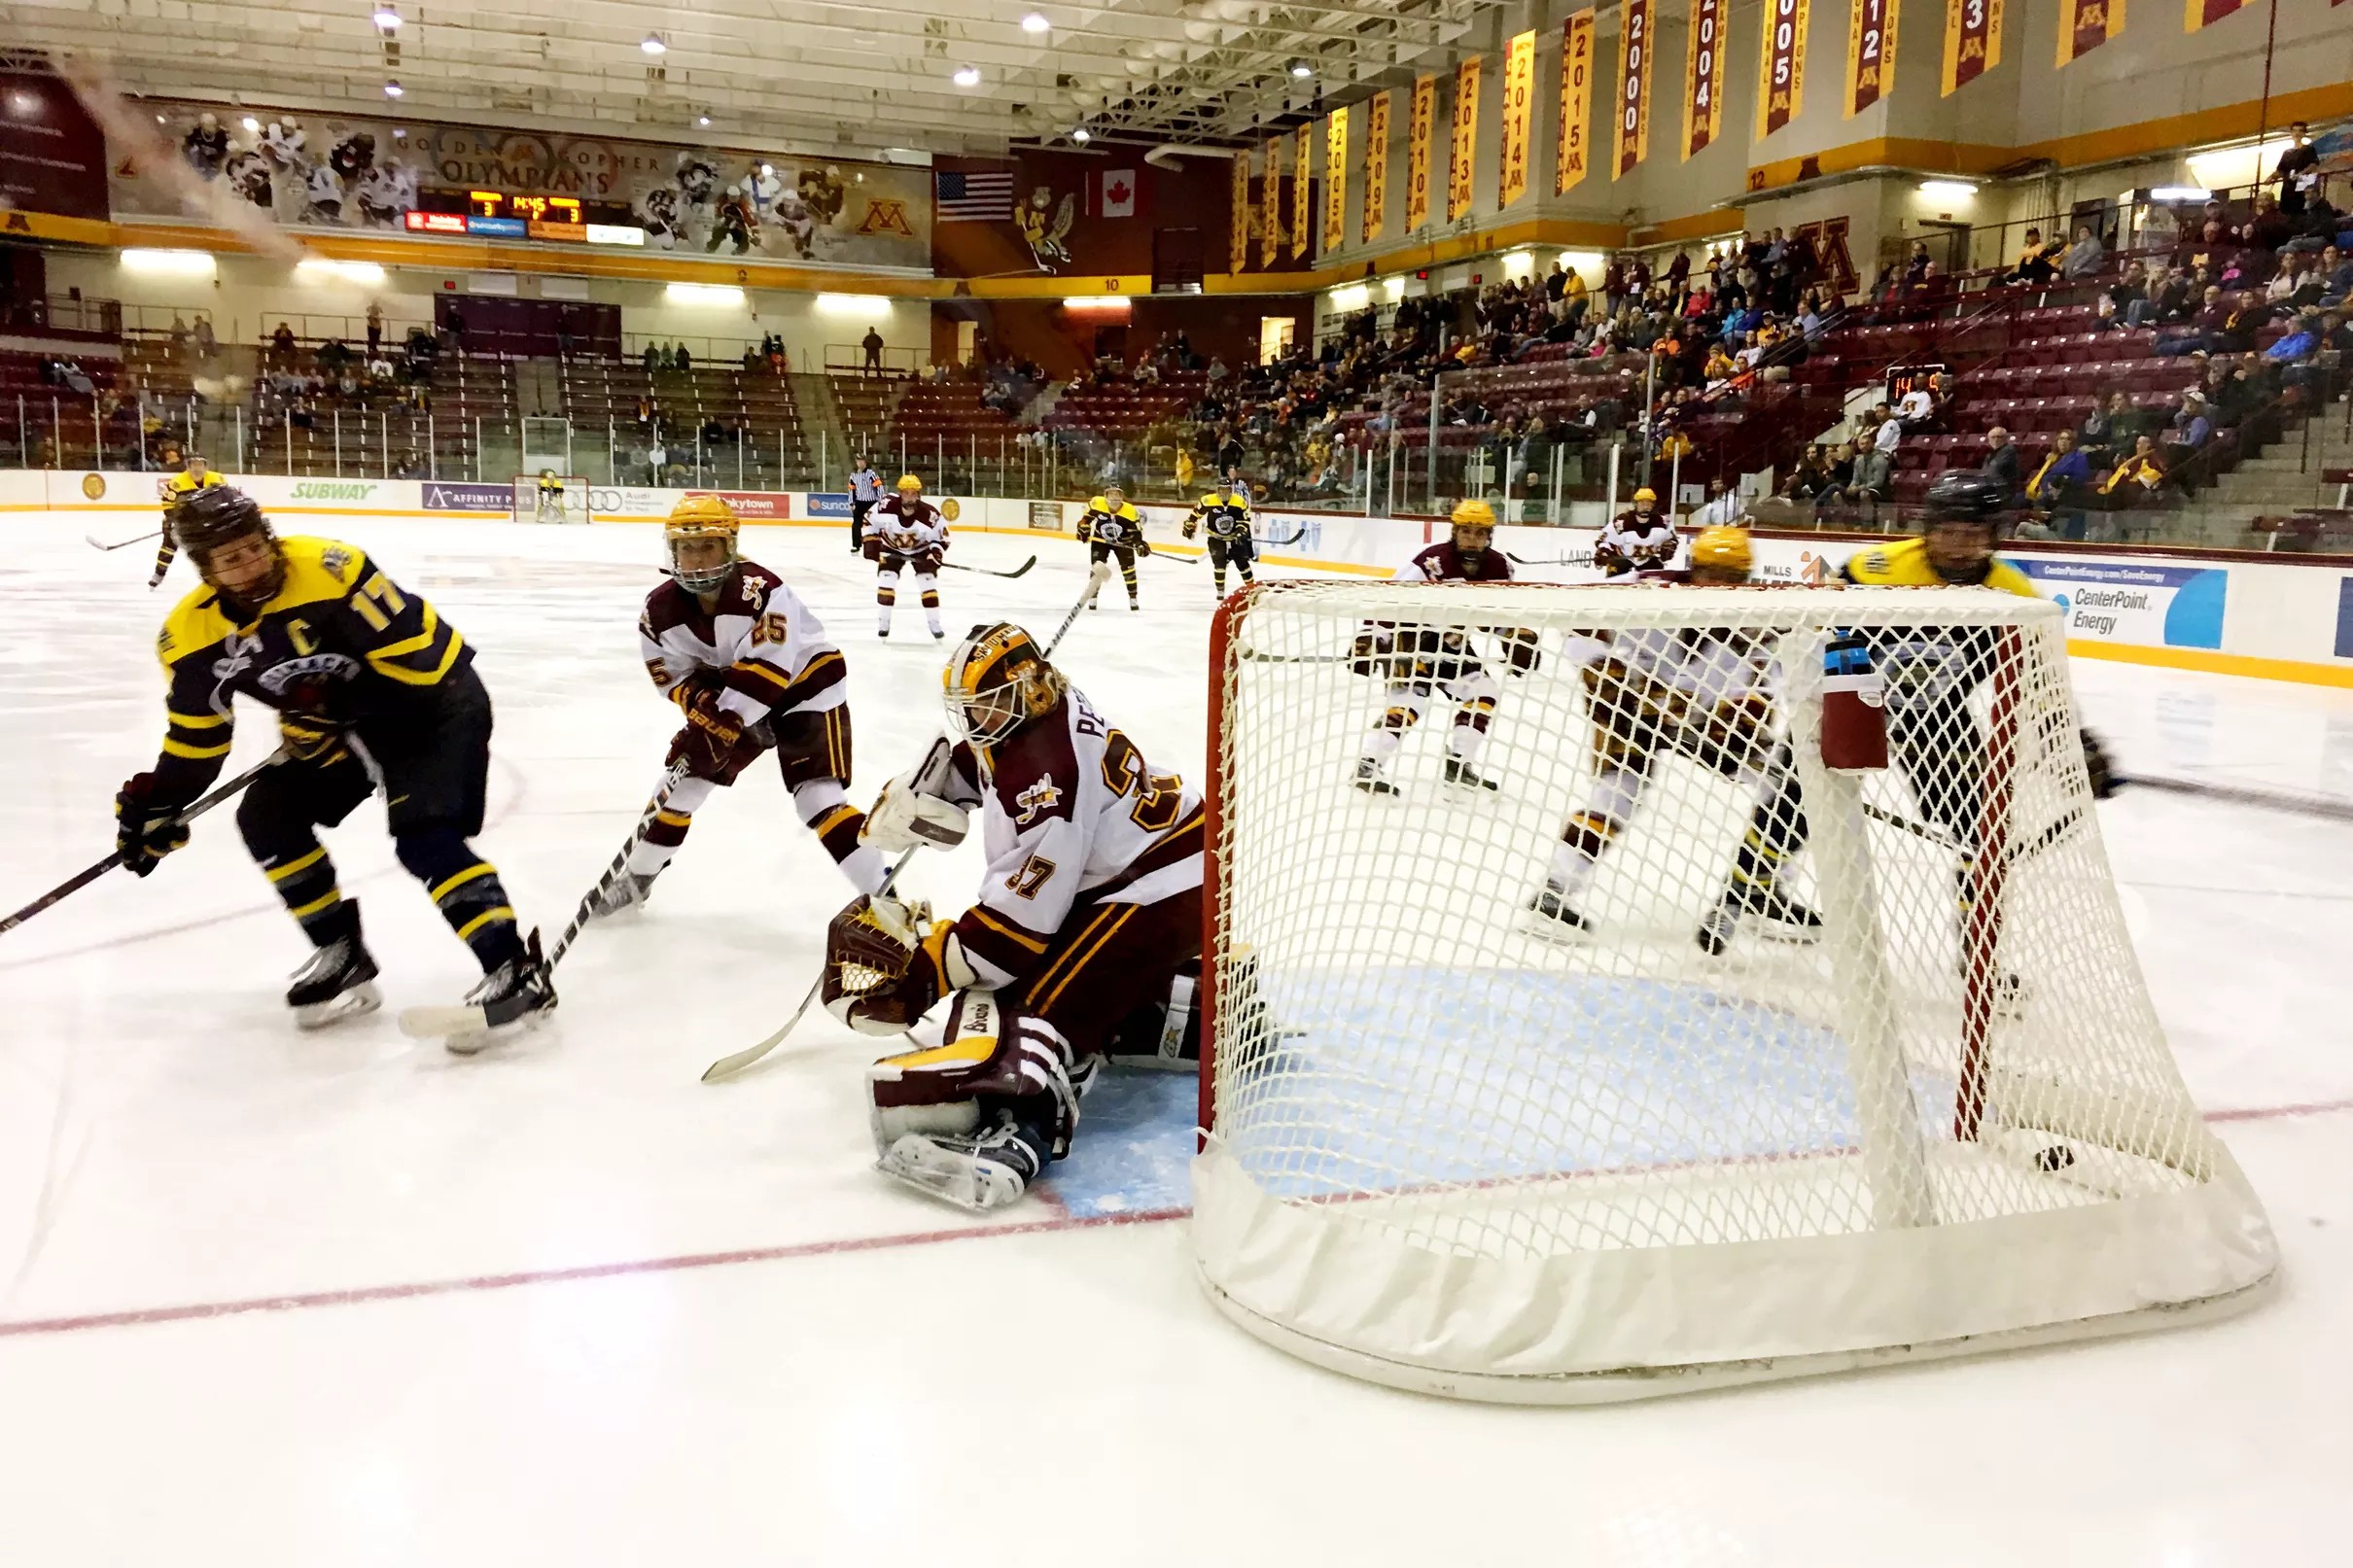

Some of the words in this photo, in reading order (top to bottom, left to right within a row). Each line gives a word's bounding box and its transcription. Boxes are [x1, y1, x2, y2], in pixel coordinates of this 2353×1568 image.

[1626, 14, 1643, 130] 2000
[1569, 33, 1586, 149] 2015
[1512, 57, 1527, 164] 2014
[1417, 95, 1428, 193] 2010
[1460, 78, 1473, 181] 2013
[396, 136, 505, 157] GOLDEN
[559, 149, 661, 172] GOPHER
[1374, 112, 1385, 205] 2009
[441, 158, 610, 194] OLYMPIANS
[1333, 128, 1343, 217] 2005
[1751, 170, 1765, 191] 12
[1106, 279, 1119, 291] 10
[290, 482, 378, 501] SUBWAY
[452, 493, 502, 504] AFFINITY
[506, 495, 533, 505] PUS
[723, 497, 774, 510] nkytown
[1560, 548, 1592, 569] LAND
[1763, 565, 1792, 577] MILLS
[349, 570, 406, 632] 17
[2075, 587, 2149, 611] CenterPoint
[286, 618, 322, 656] C
[2073, 610, 2117, 635] Energy
